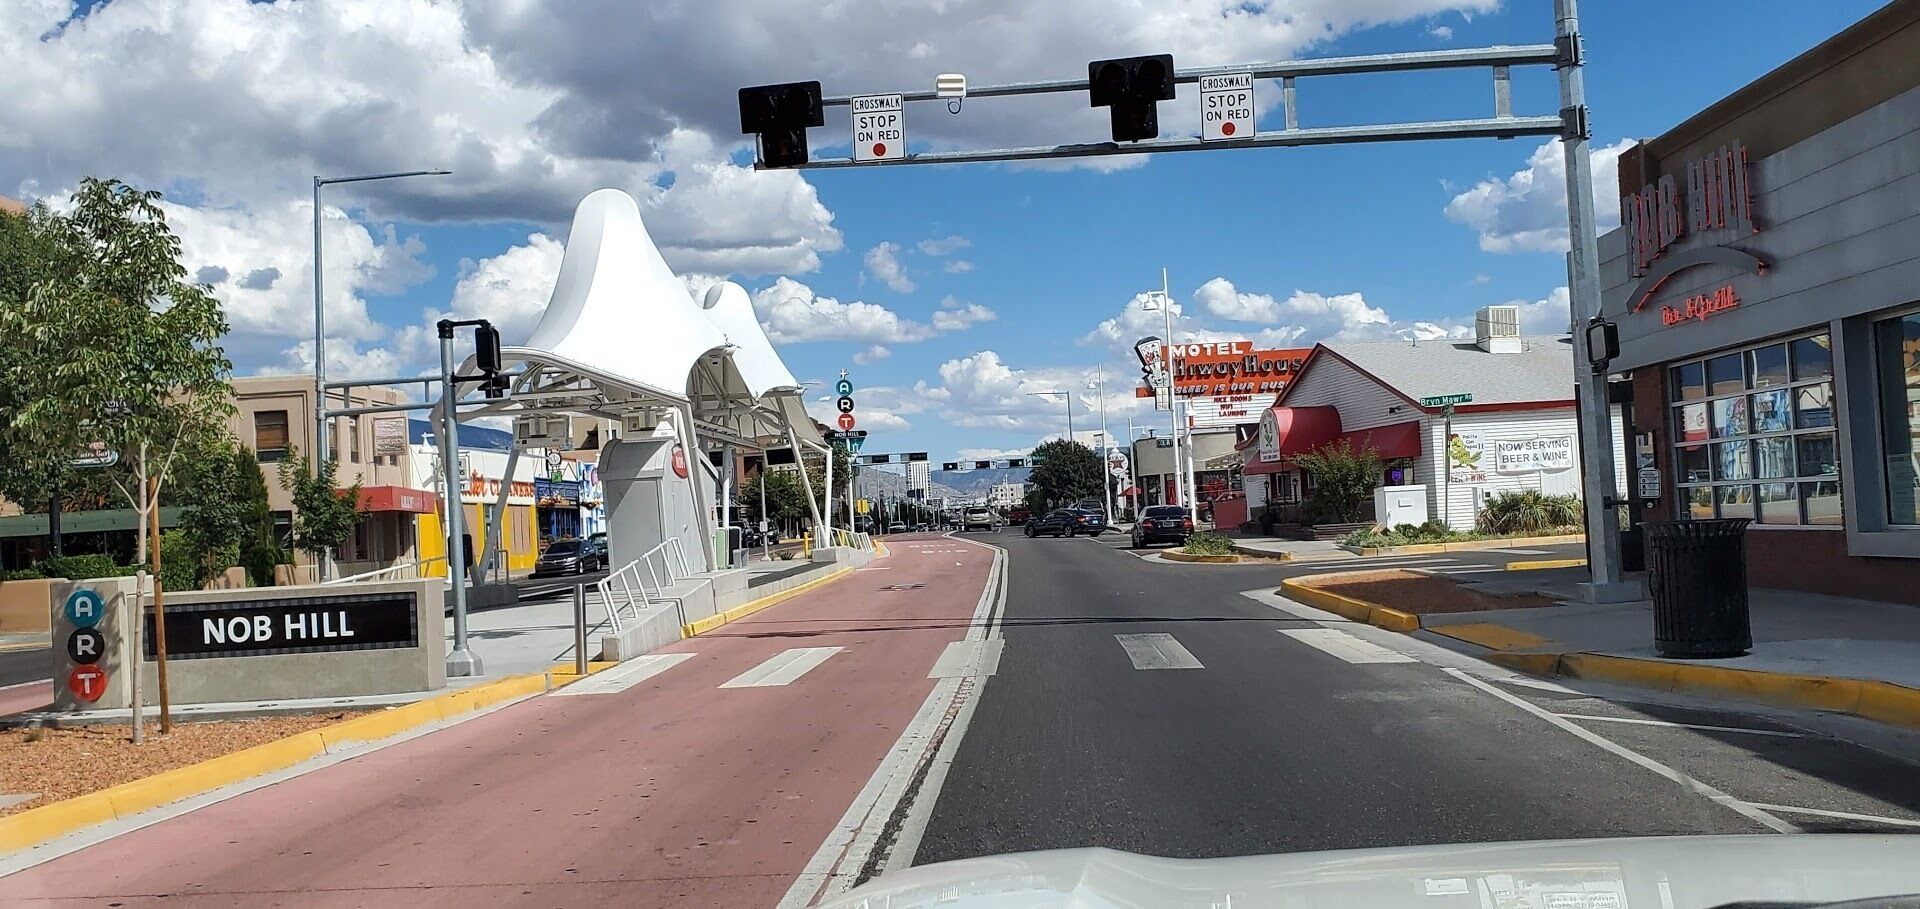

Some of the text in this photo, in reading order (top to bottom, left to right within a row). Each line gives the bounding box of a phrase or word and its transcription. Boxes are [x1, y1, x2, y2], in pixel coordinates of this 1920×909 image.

[1203, 76, 1250, 89] CROSSWALK
[854, 97, 900, 110] CROSSWALK
[1208, 94, 1246, 108] STOP
[860, 115, 896, 128] STOP
[1206, 109, 1250, 121] ON RED
[858, 130, 900, 141] ON RED
[1623, 137, 1757, 281] NOB HILL
[1170, 342, 1244, 357] MOTEL
[1174, 380, 1288, 394] SLEEP IS OUR BUS
[1230, 395, 1253, 403] ROOMS
[1420, 398, 1440, 406] Bryn
[1442, 395, 1463, 405] Mawr
[1498, 439, 1569, 452] NOW SERVING
[1502, 451, 1568, 463] BEER & WINE
[1471, 473, 1487, 482] WINE
[490, 479, 534, 497] CLANERS
[203, 611, 354, 645] NOB HILL
